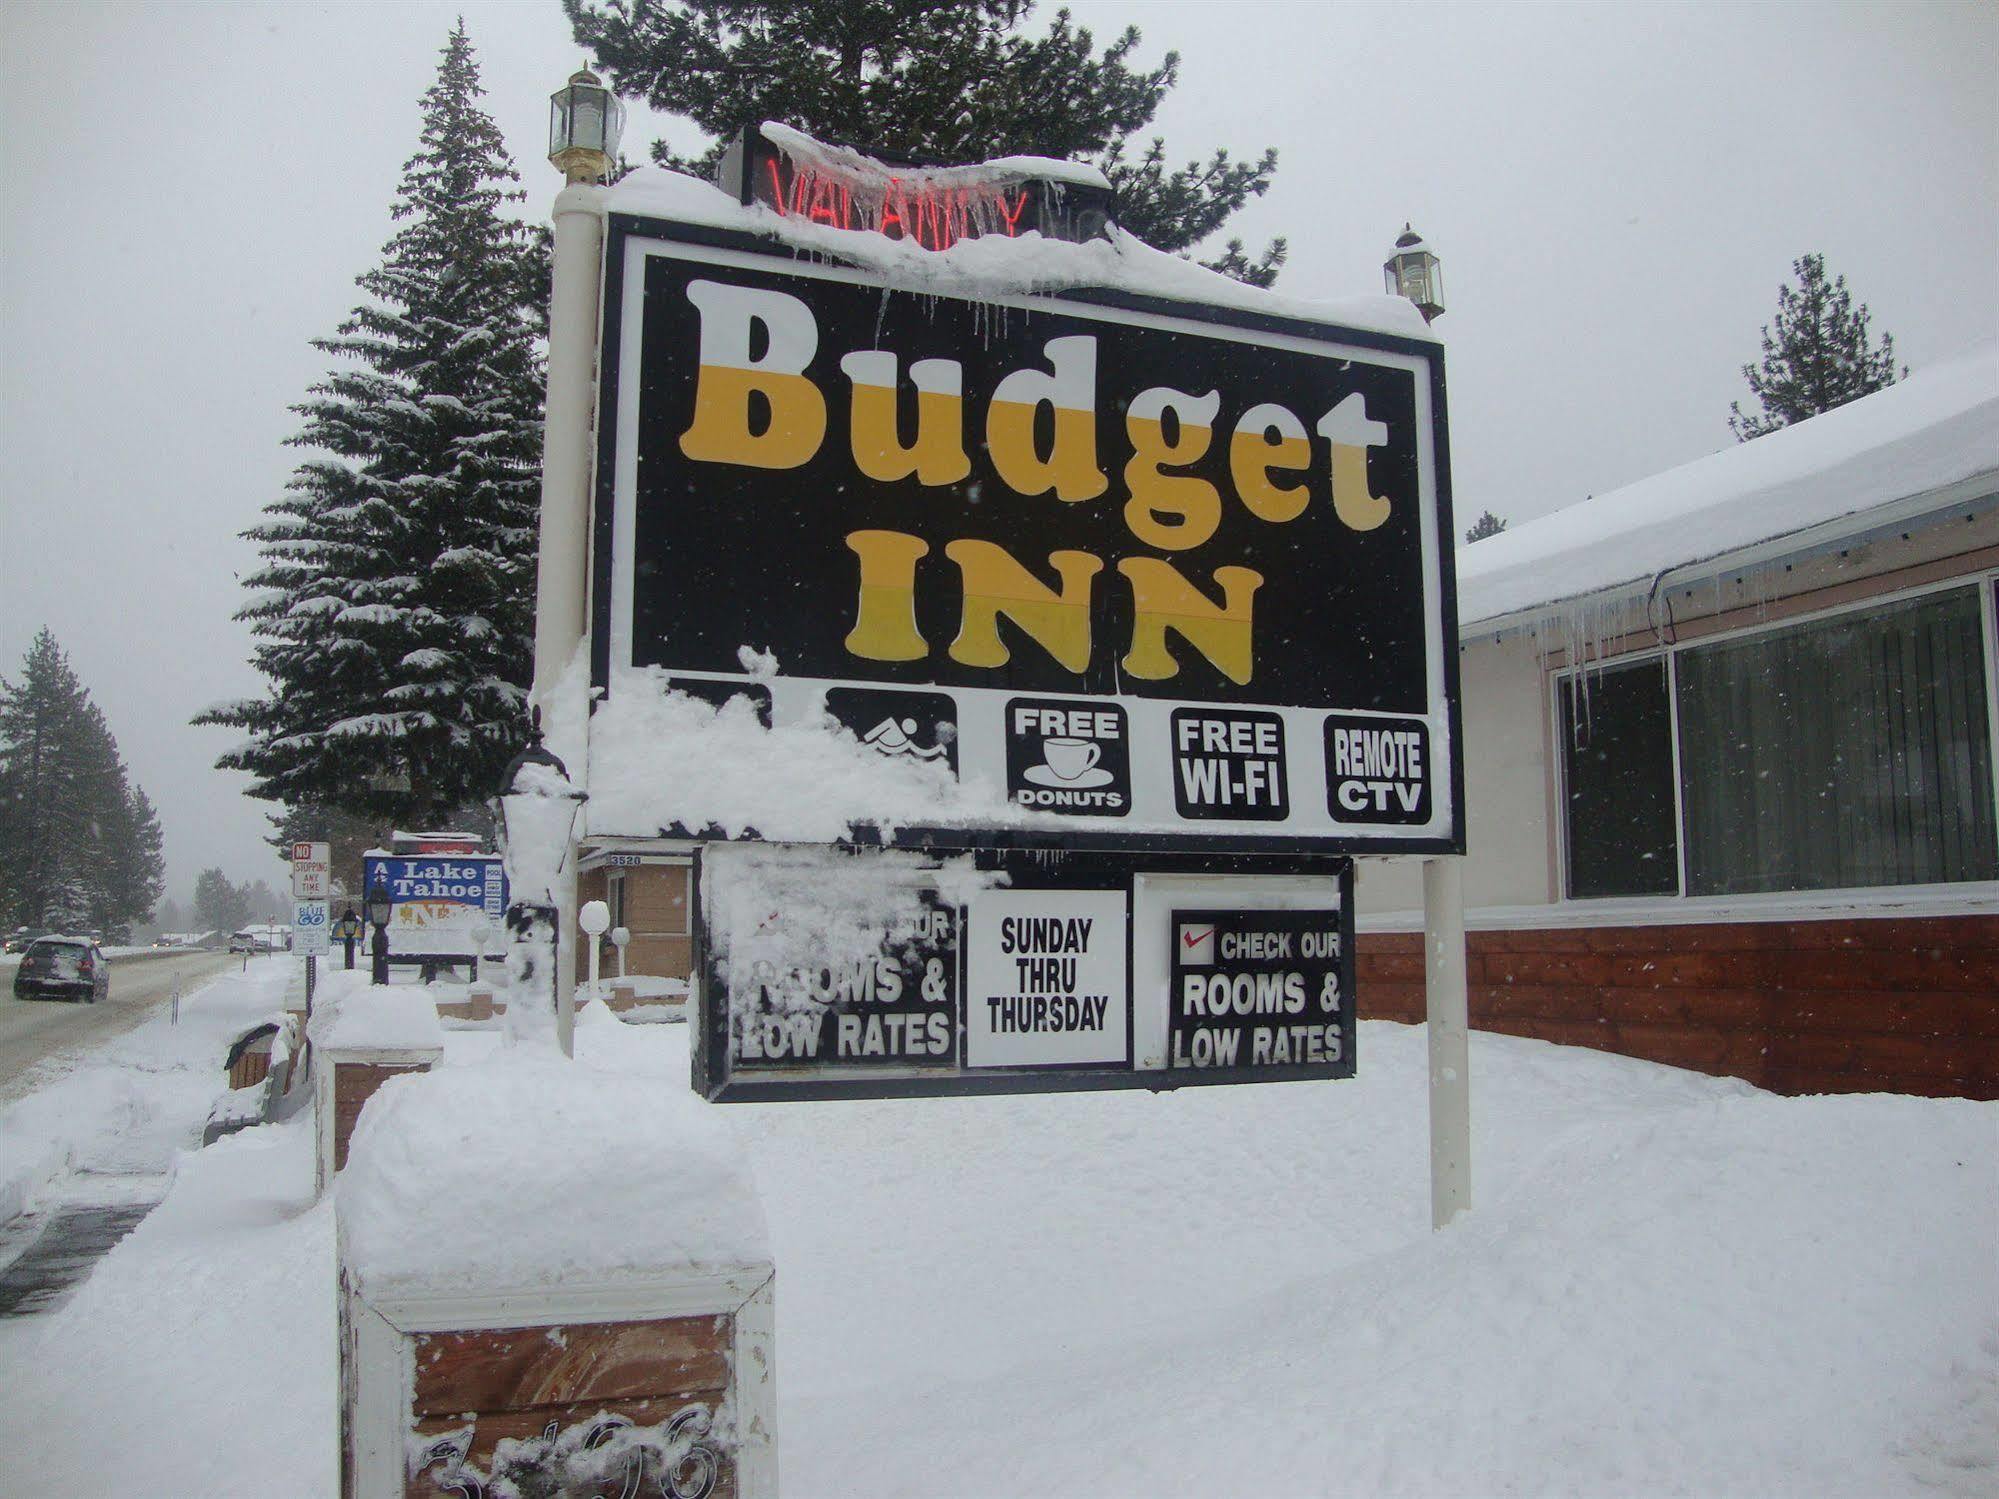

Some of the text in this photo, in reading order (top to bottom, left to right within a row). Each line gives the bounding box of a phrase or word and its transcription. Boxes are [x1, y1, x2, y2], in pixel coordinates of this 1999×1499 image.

[679, 279, 1391, 550] Budget
[845, 529, 1264, 685] INN
[1015, 708, 1119, 739] FREE
[1177, 718, 1279, 754] FREE
[1334, 729, 1422, 778] REMOTE
[1018, 789, 1123, 807] DONUTS
[1180, 758, 1280, 806] WI-FI
[1337, 780, 1422, 812] CTV
[296, 845, 310, 858] NO
[296, 862, 327, 872] STOPPING
[303, 883, 319, 891] TIME
[304, 874, 319, 882] ANY
[393, 879, 482, 897] Tahoe
[404, 862, 477, 879] Lake
[298, 914, 324, 926] GO
[1001, 917, 1093, 954] SUNDAY
[1221, 931, 1341, 960] CHECK OUR
[752, 957, 948, 1003] ROMS &
[1016, 958, 1077, 993] THRU
[1183, 971, 1341, 1016] ROOMS &
[987, 996, 1108, 1033] THURSDAY
[741, 1012, 950, 1059] LOW RATES
[1173, 1025, 1343, 1068] LOW RATES
